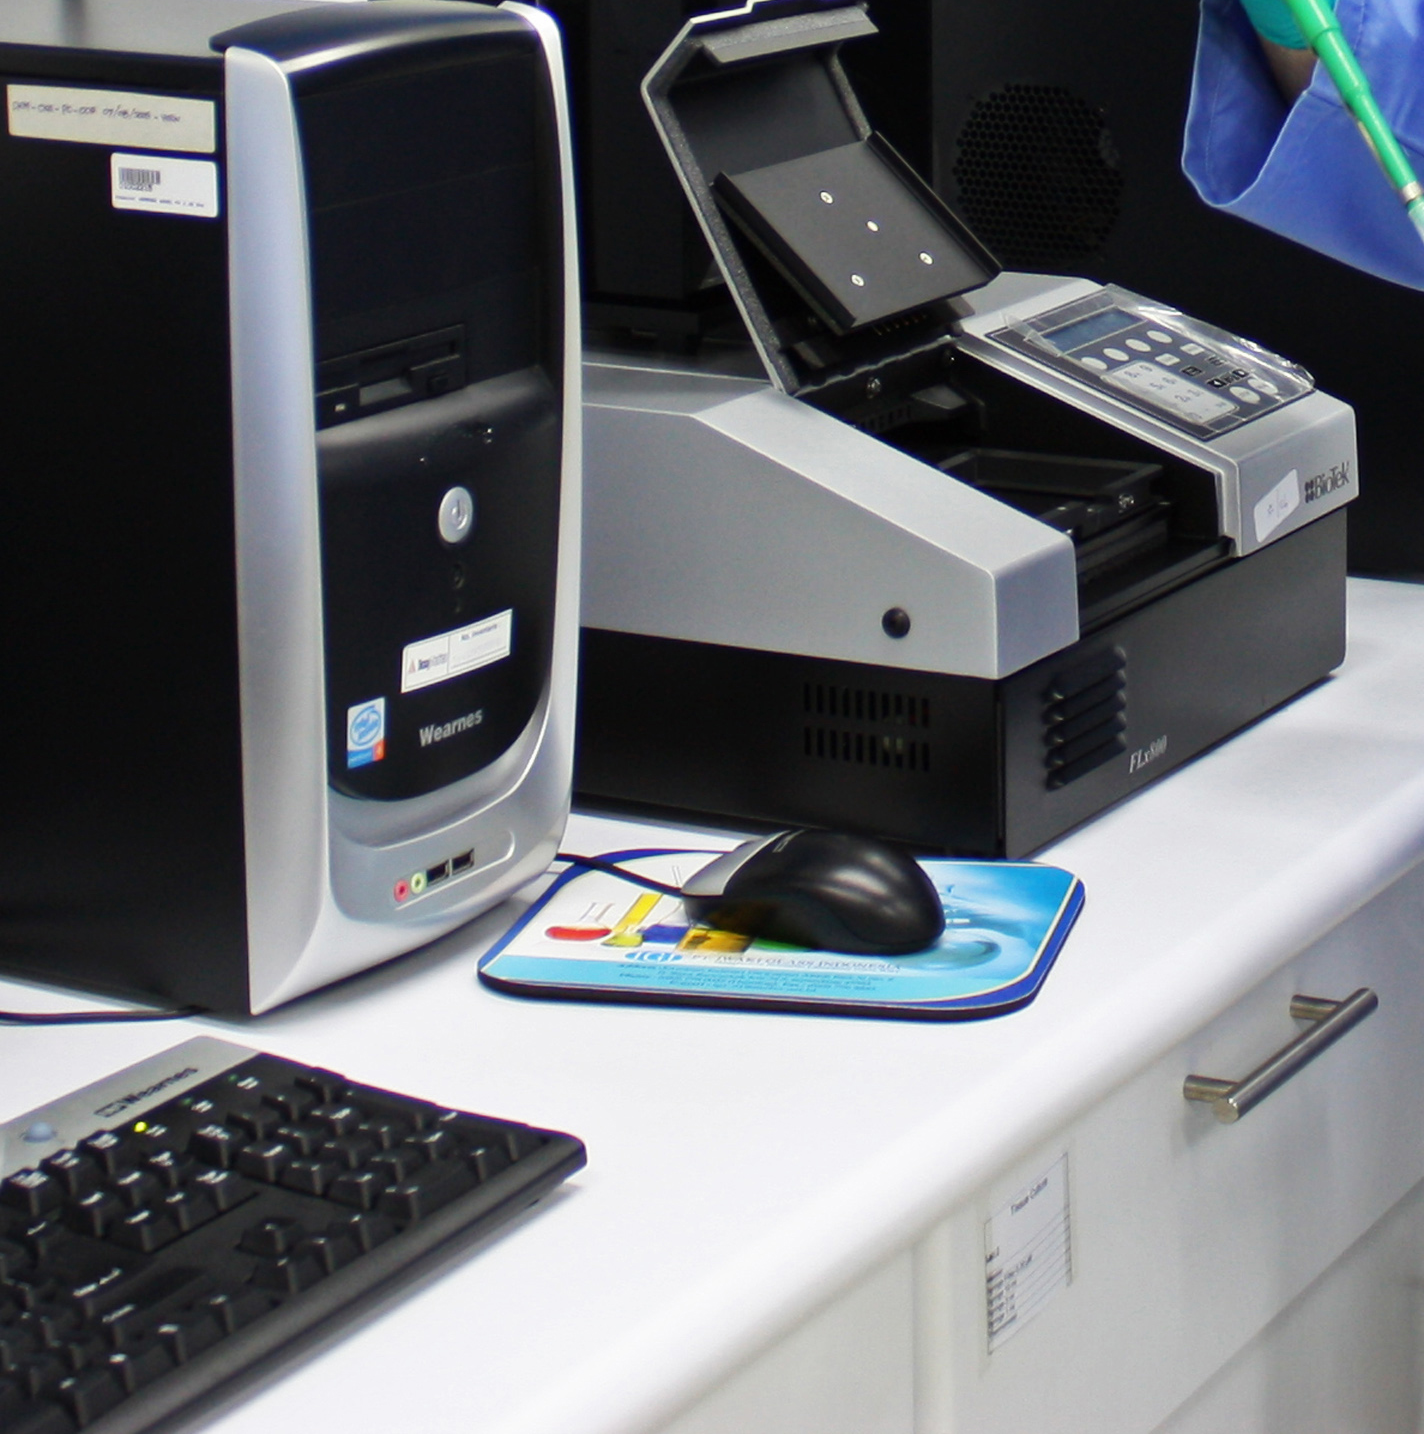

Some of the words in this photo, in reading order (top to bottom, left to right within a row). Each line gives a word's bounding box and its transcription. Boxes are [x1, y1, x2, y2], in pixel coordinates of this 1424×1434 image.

[1314, 461, 1350, 500] BioTek
[418, 708, 483, 748] Wearnes
[1128, 735, 1168, 775] FLx800
